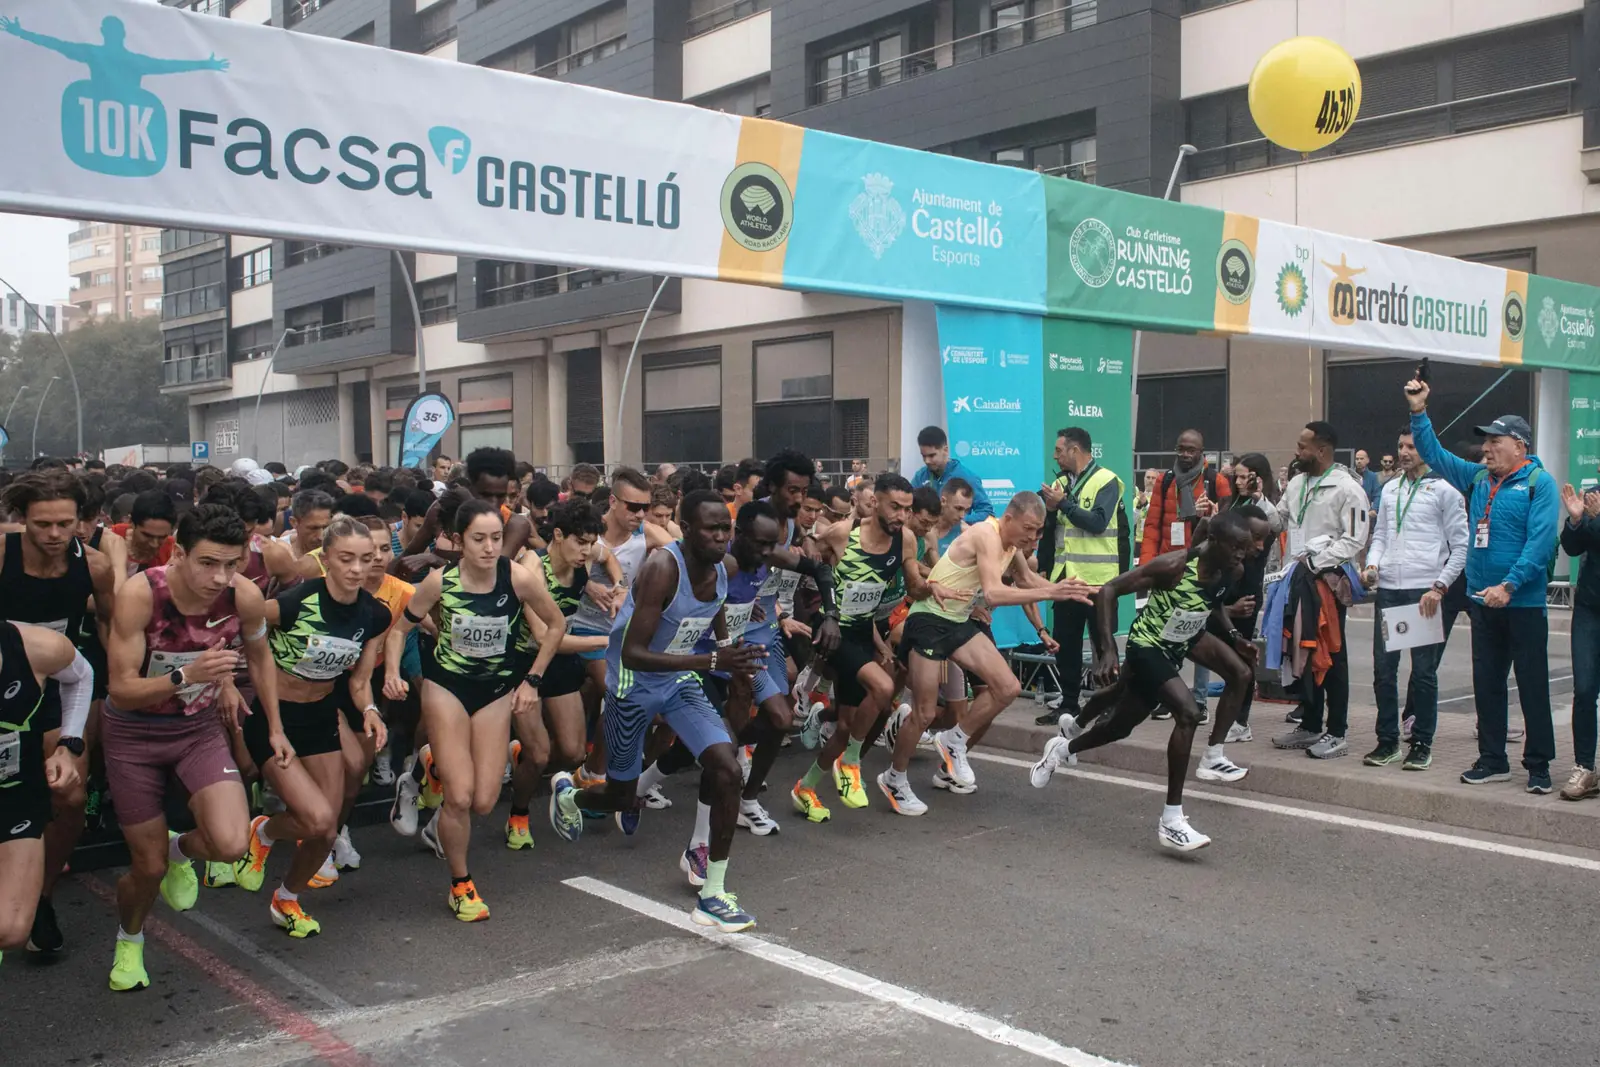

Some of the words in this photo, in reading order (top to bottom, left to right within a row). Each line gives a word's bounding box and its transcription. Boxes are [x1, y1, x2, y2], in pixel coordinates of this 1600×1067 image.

[78, 97, 156, 161] 10K
[179, 109, 433, 199] Facsa
[477, 155, 681, 230] CASTELLÓ
[912, 188, 982, 213] Ajuntament
[988, 200, 1003, 216] de
[740, 219, 772, 231] ATHLETICS
[746, 213, 767, 224] WORLD
[744, 238, 761, 248] ROAD
[776, 222, 790, 241] LABEL
[912, 209, 1003, 248] Castelló
[1126, 225, 1142, 238] Club
[1144, 230, 1181, 245] d'atletisme
[932, 245, 980, 267] Esports
[1117, 239, 1190, 270] RUNNING
[1296, 244, 1309, 262] bp
[1116, 265, 1192, 295] CASTELLÓ
[1333, 282, 1408, 327] marató
[1412, 296, 1488, 338] CASTELLÓ
[1560, 316, 1595, 338] Castelló
[973, 397, 1022, 410] CaixaBank
[1068, 405, 1103, 418] SALERA
[195, 443, 206, 457] P
[971, 447, 1021, 456] BAVIERA
[852, 590, 881, 602] 2038
[463, 628, 502, 642] 2054
[463, 640, 495, 648] CRISTINA
[682, 630, 700, 643] 20
[313, 650, 354, 666] 2048
